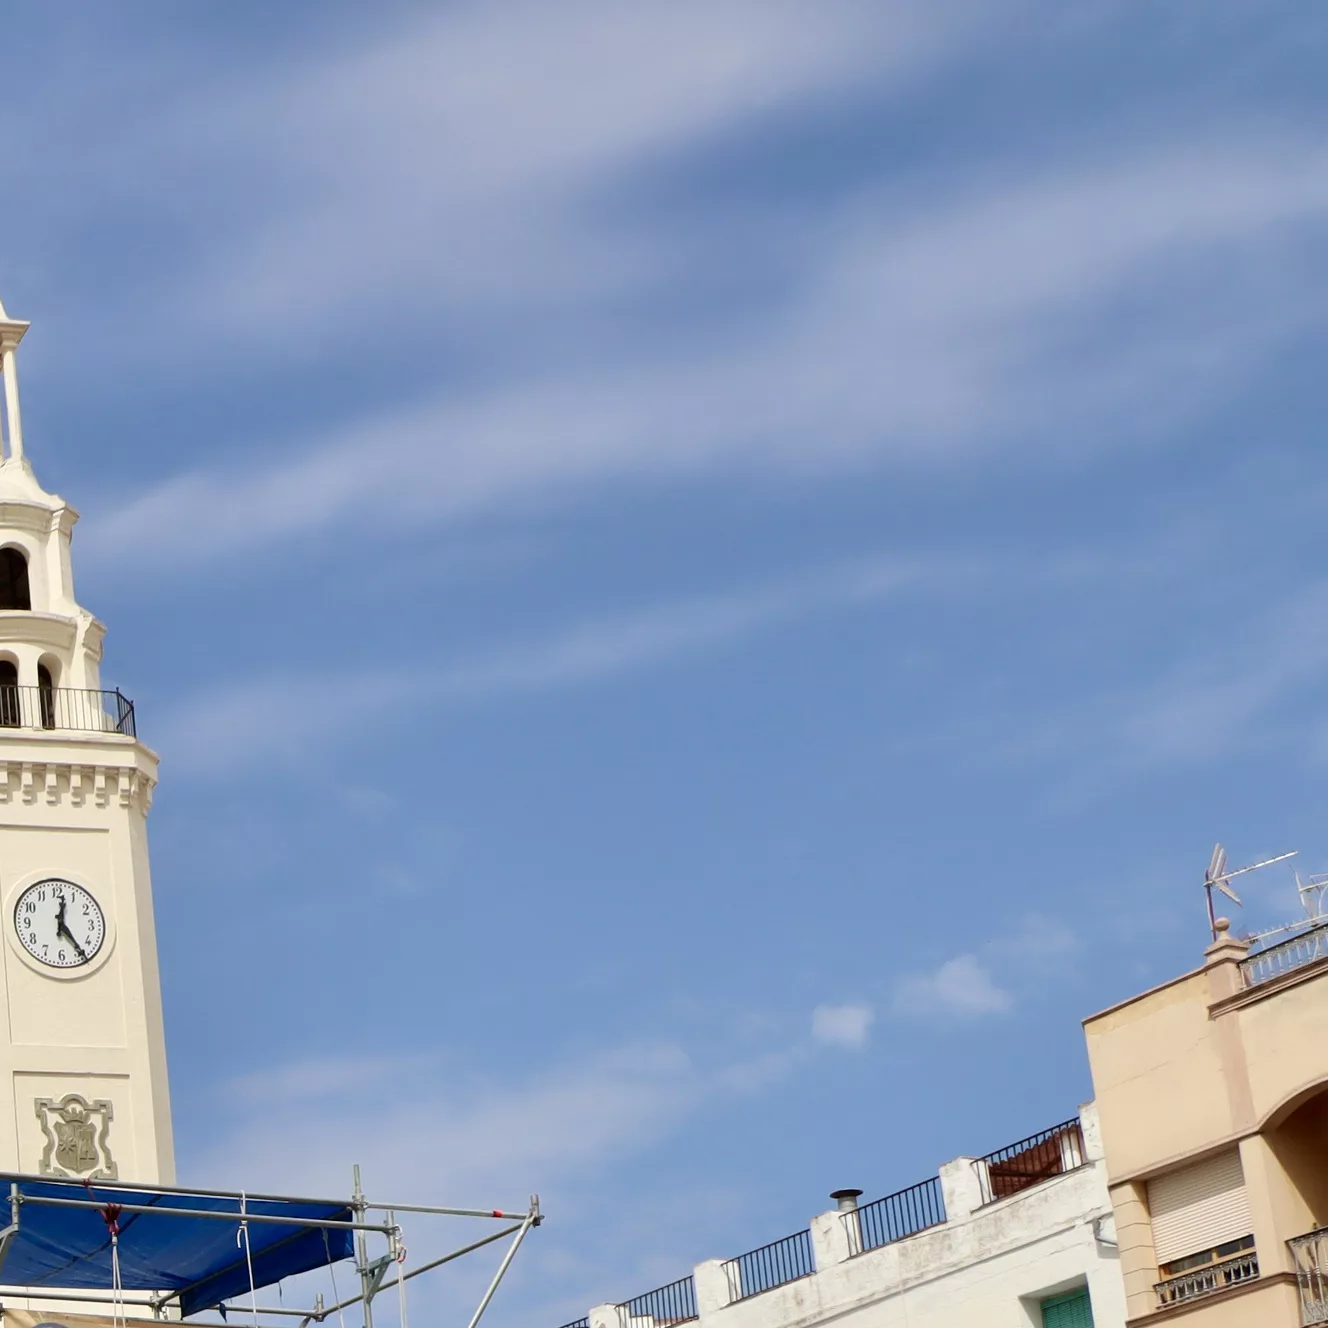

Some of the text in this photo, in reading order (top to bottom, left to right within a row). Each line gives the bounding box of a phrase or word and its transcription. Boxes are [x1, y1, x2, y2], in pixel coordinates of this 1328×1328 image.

[38, 890, 45, 902] 11
[52, 887, 63, 899] 12
[71, 892, 76, 903] 1
[25, 902, 36, 913] 10
[82, 904, 90, 916] 2
[24, 917, 31, 929] 9
[88, 919, 95, 931] 3
[29, 932, 37, 945] 8
[85, 935, 91, 946] 4
[42, 944, 49, 956] 7
[58, 949, 66, 961] 6
